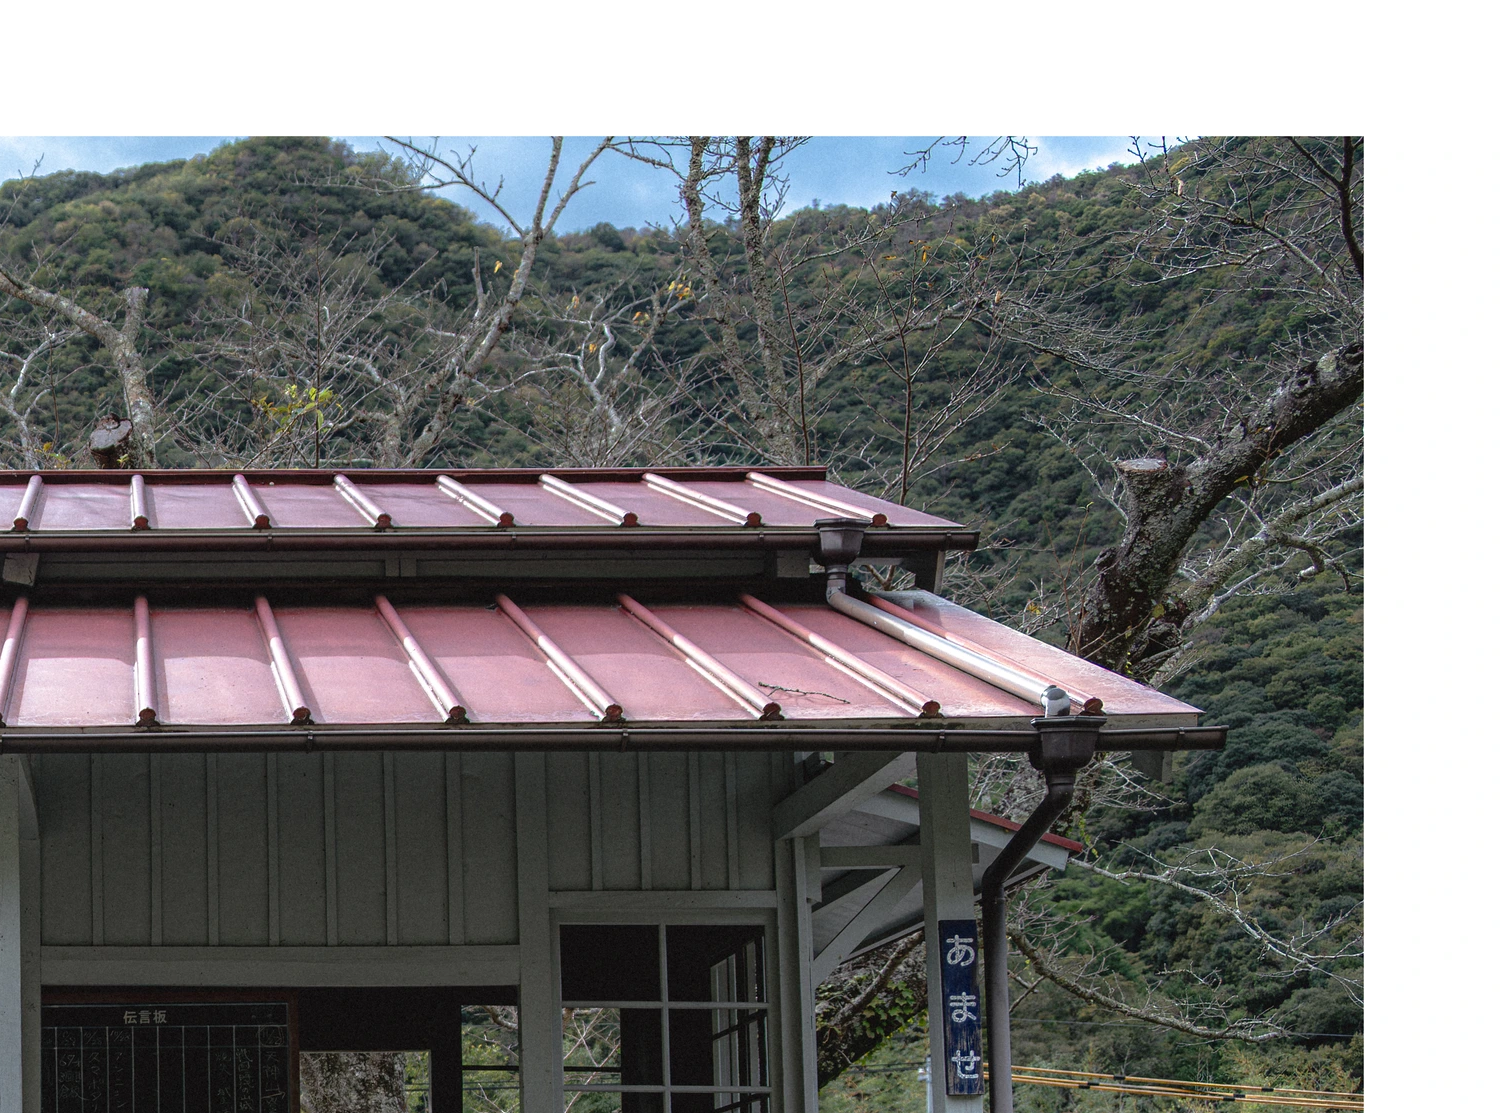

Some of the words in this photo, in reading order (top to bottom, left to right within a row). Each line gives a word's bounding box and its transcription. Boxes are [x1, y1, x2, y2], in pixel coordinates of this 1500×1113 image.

[123, 1010, 167, 1024] 伝言板
[946, 934, 980, 1079] あませ
